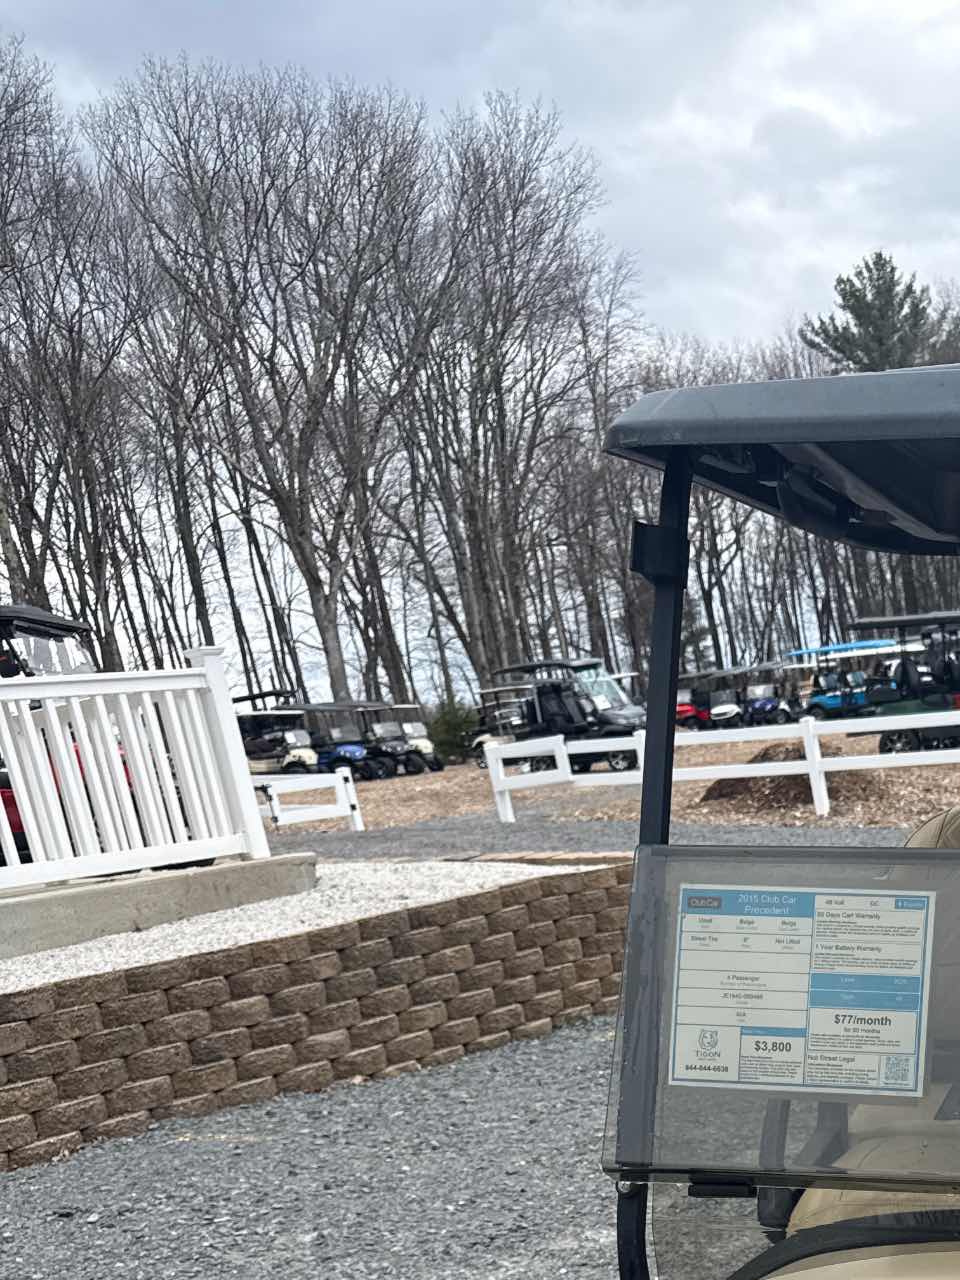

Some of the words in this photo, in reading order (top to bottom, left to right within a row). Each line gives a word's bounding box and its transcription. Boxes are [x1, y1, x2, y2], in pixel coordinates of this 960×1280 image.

[760, 895, 780, 904] Club
[781, 895, 798, 905] Car
[744, 905, 790, 915] Precedent
[855, 912, 881, 921] Warranty
[834, 945, 856, 953] Battery
[856, 945, 882, 953] Warranty
[731, 975, 760, 983] Passenger
[833, 1013, 892, 1027] $77/month
[754, 1040, 792, 1053] $3,800
